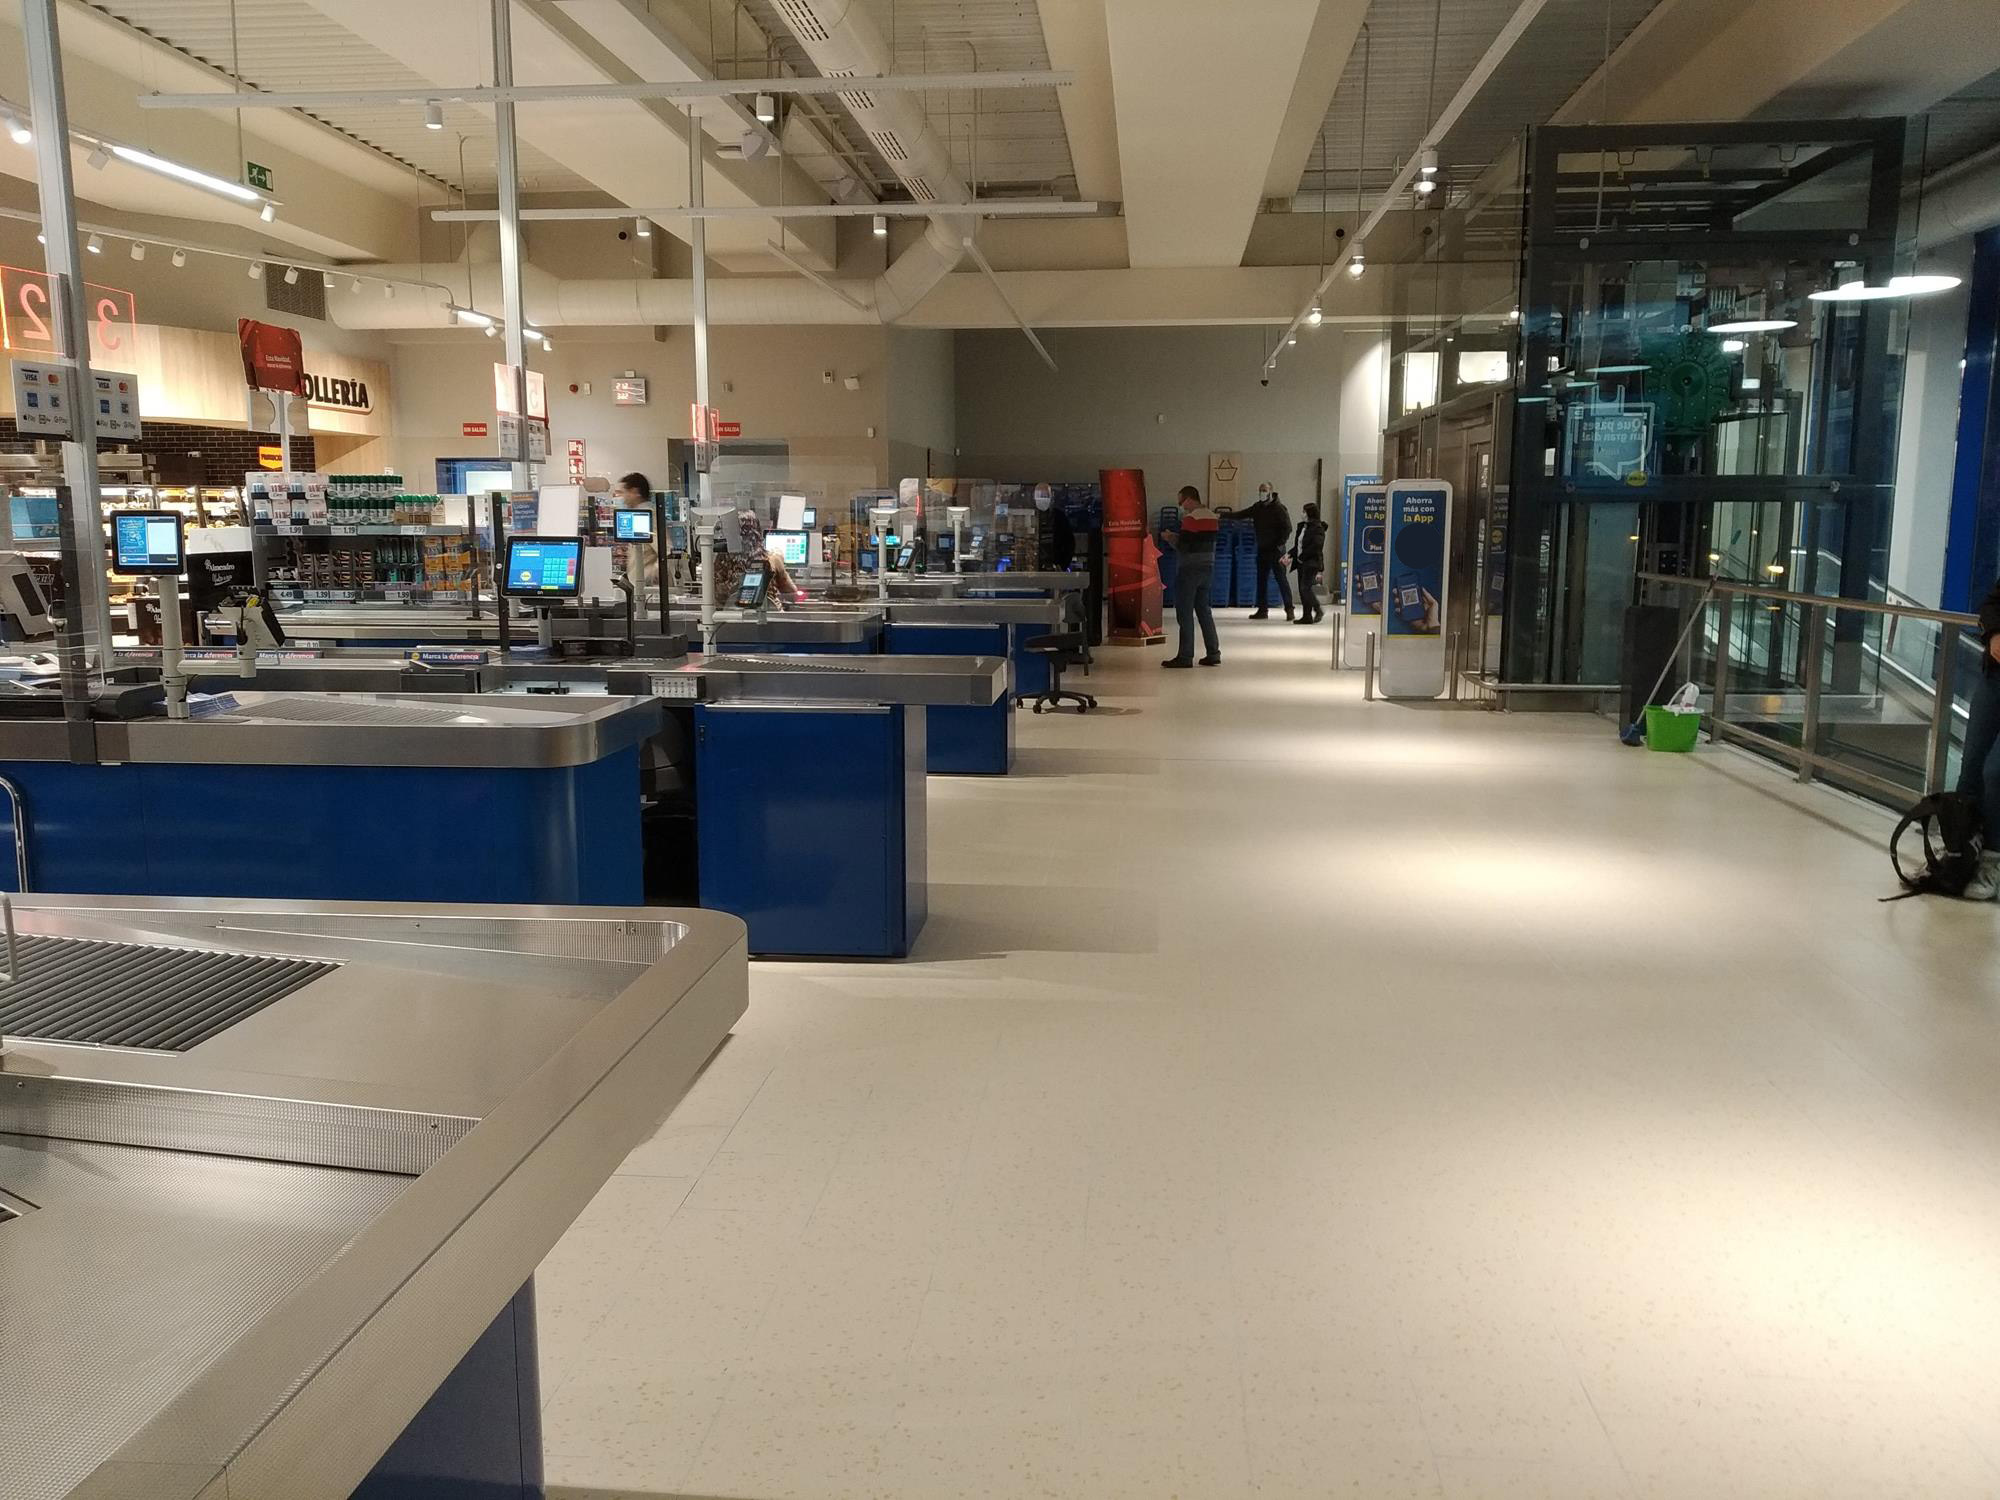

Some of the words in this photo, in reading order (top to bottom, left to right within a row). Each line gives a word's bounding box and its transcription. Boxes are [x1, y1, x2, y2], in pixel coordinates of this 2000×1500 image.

[24, 373, 38, 381] VISA
[98, 381, 110, 389] VISA
[1403, 505, 1418, 513] más
[1403, 514, 1412, 522] la
[1413, 514, 1434, 523] App
